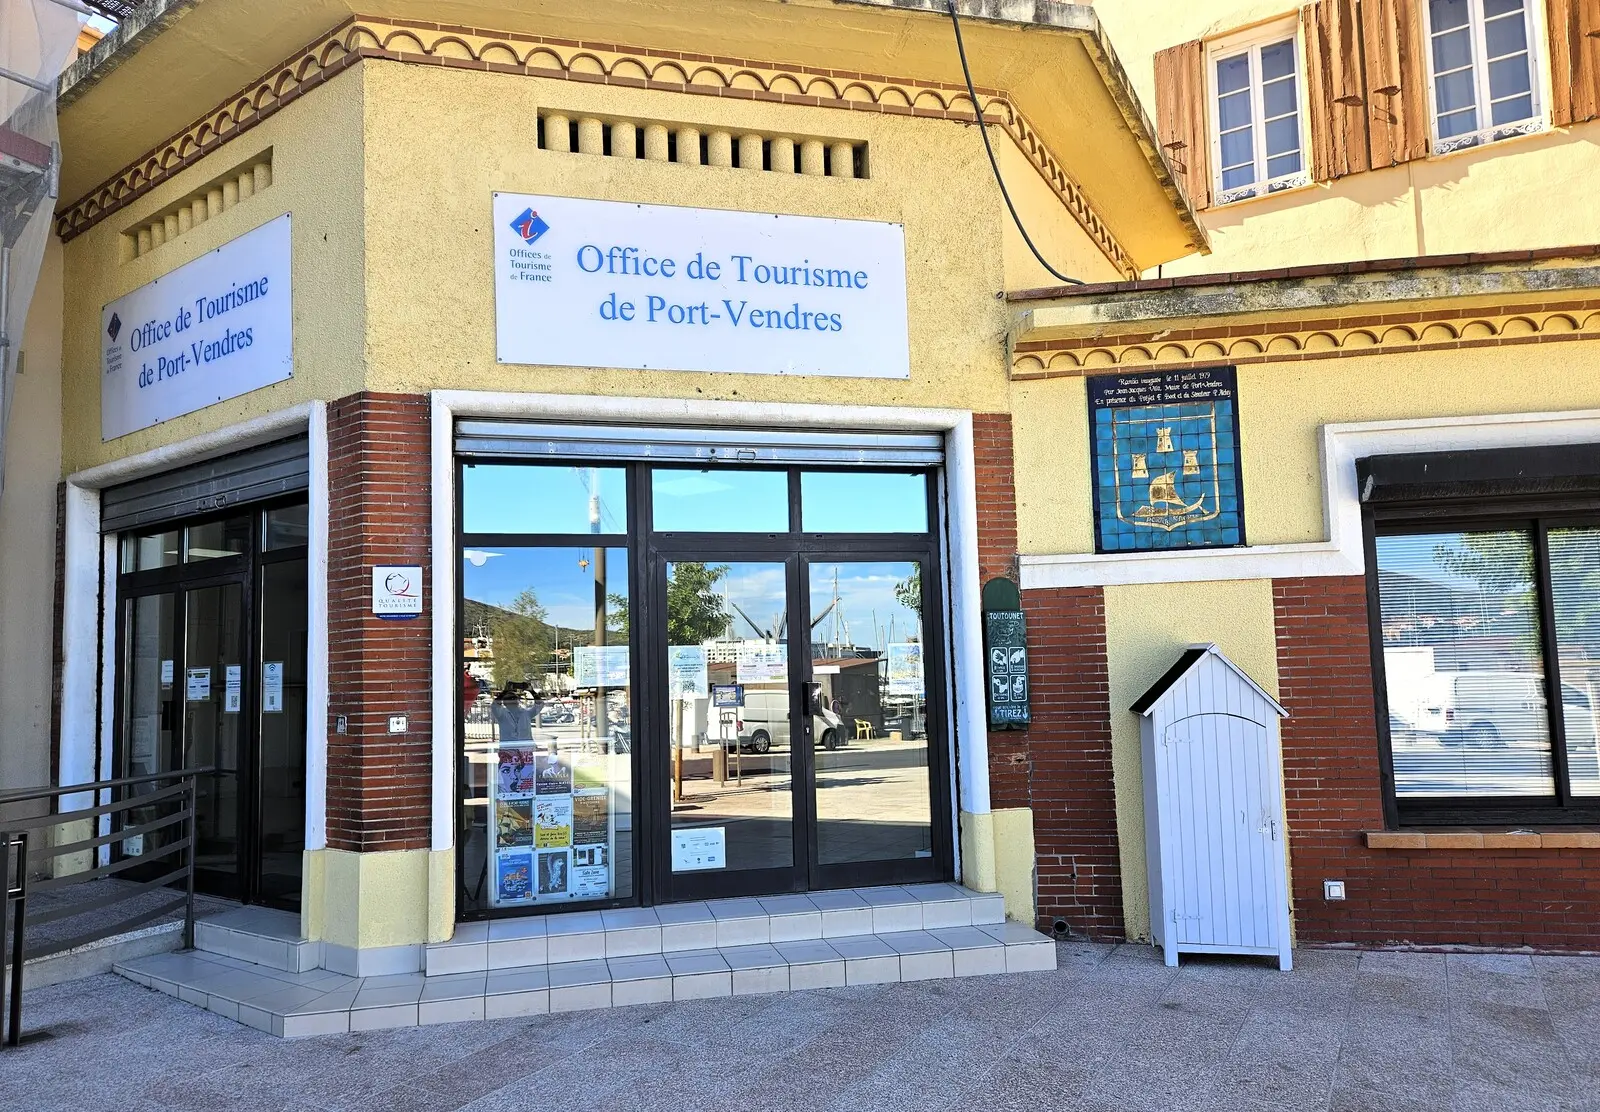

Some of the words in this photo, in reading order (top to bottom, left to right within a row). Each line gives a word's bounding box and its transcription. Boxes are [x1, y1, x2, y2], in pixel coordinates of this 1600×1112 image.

[509, 248, 542, 259] Offices
[510, 259, 552, 271] Tourisme
[577, 244, 676, 278] Office
[687, 251, 721, 281] de
[731, 255, 869, 290] Tourisme
[520, 271, 552, 282] France
[130, 319, 171, 352] Office
[175, 306, 192, 332] de
[195, 275, 269, 324] Tourisme
[599, 292, 636, 322] de
[646, 295, 843, 332] Port-Vendres
[138, 363, 154, 389] de
[157, 327, 253, 382] Port-Vendres
[989, 612, 1024, 620] TOUTOUNET
[1000, 709, 1022, 718] TIREZ
